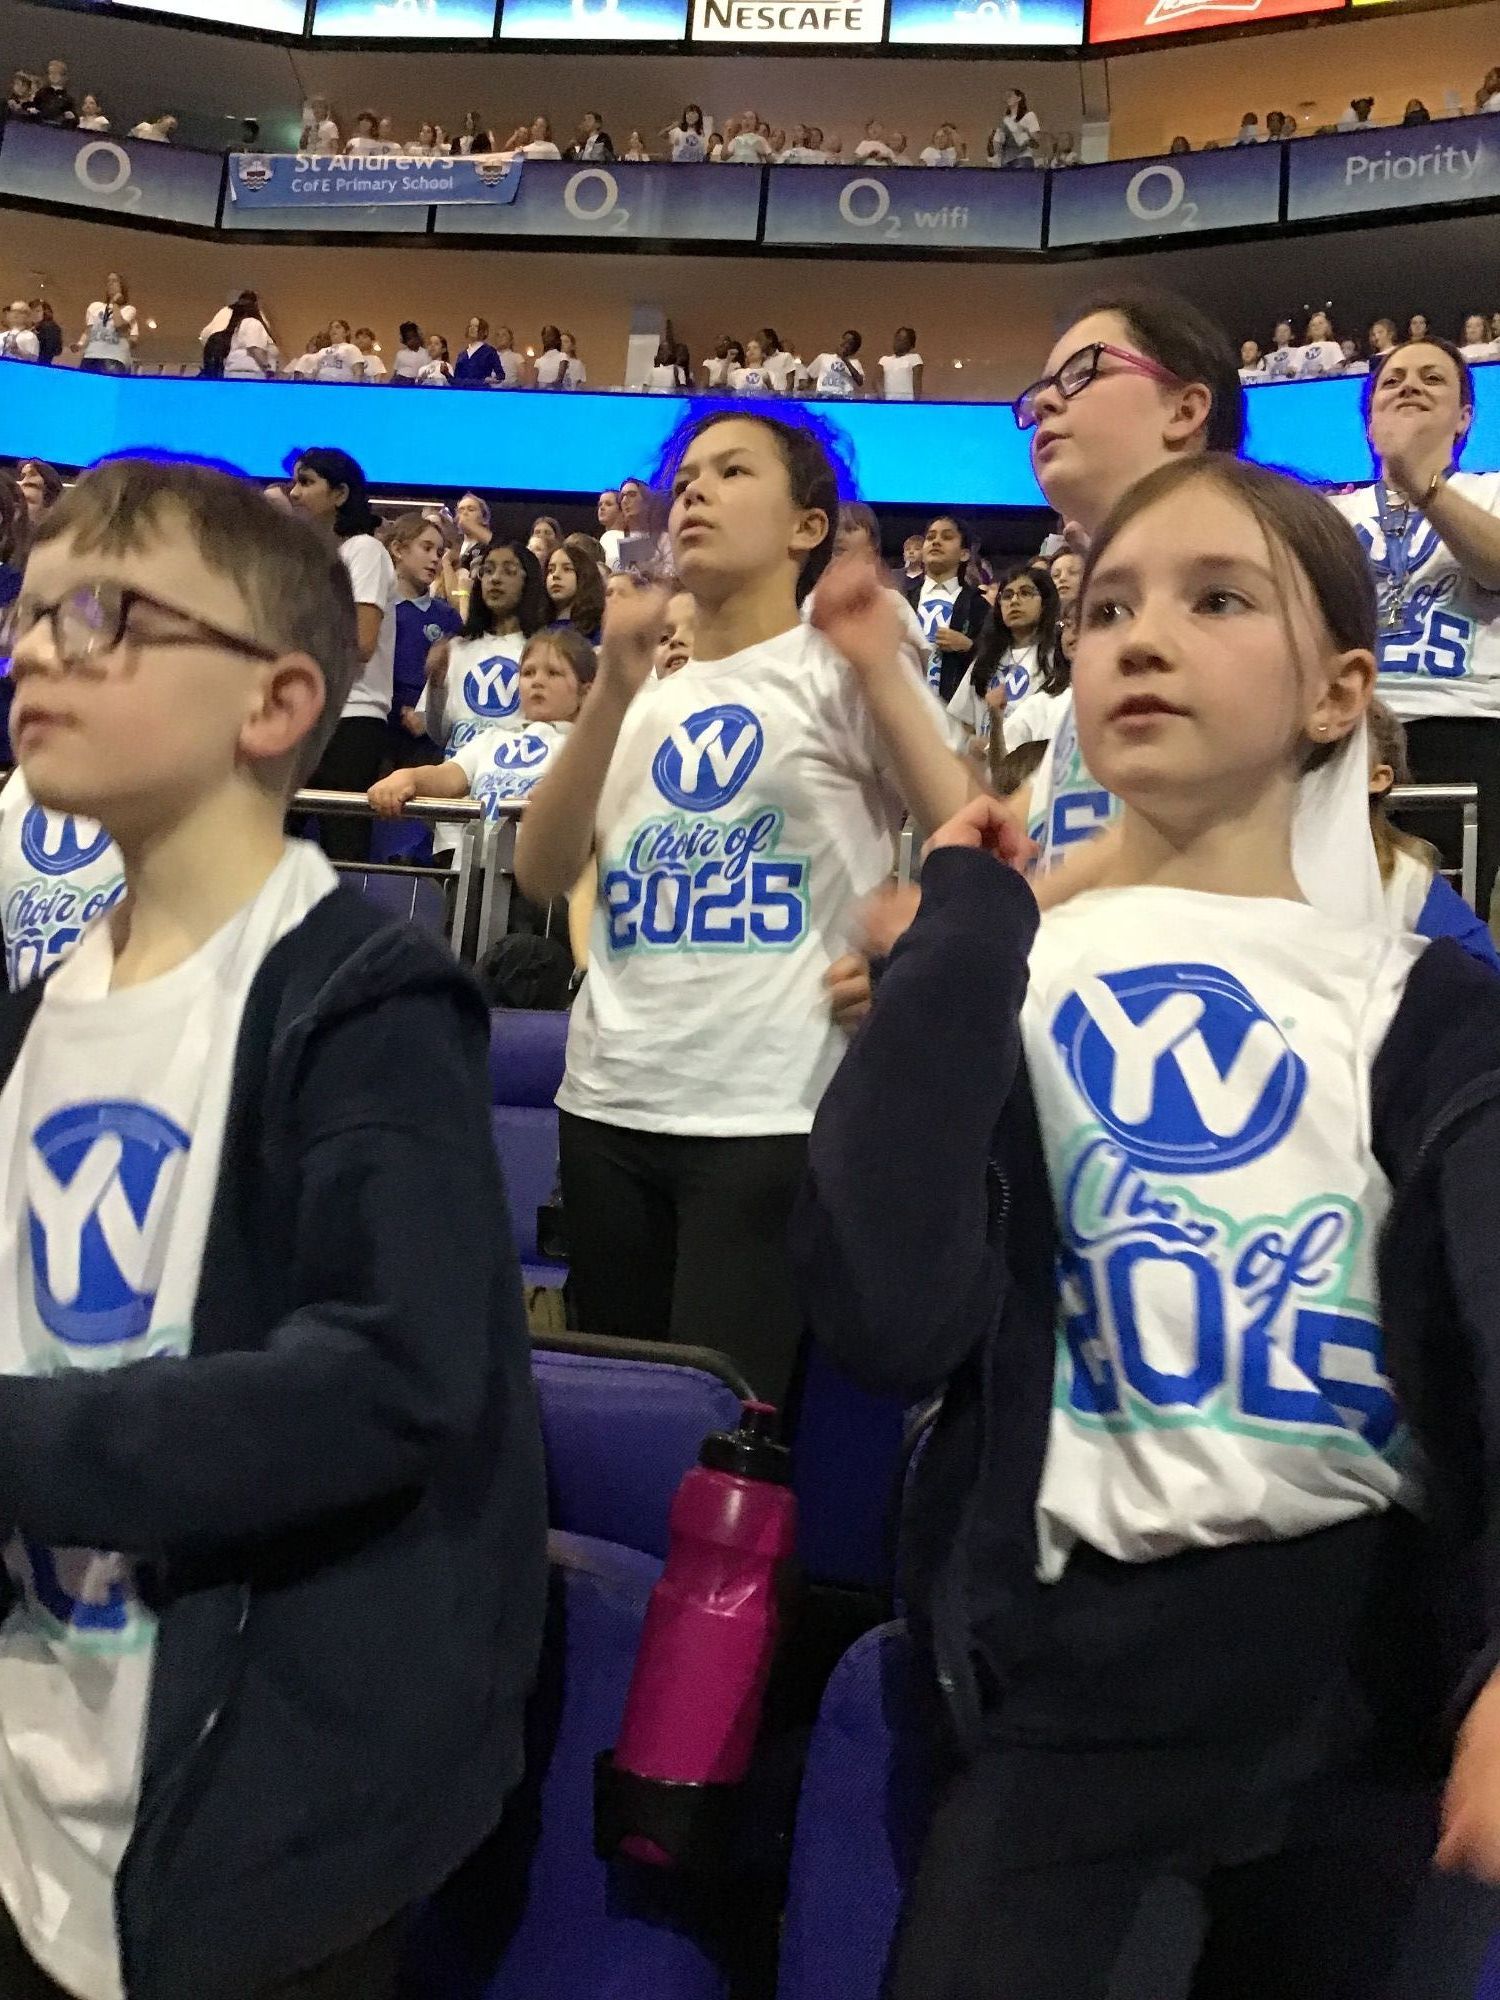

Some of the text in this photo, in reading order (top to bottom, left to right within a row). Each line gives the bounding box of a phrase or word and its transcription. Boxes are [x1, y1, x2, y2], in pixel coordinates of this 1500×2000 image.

[295, 154, 321, 172] St
[335, 177, 398, 194] Primary
[402, 176, 454, 190] School
[1345, 141, 1482, 185] Priority
[914, 206, 969, 229] wifi
[628, 813, 777, 881] Choir of
[604, 861, 804, 952] 2025
[1233, 1210, 1345, 1332] of
